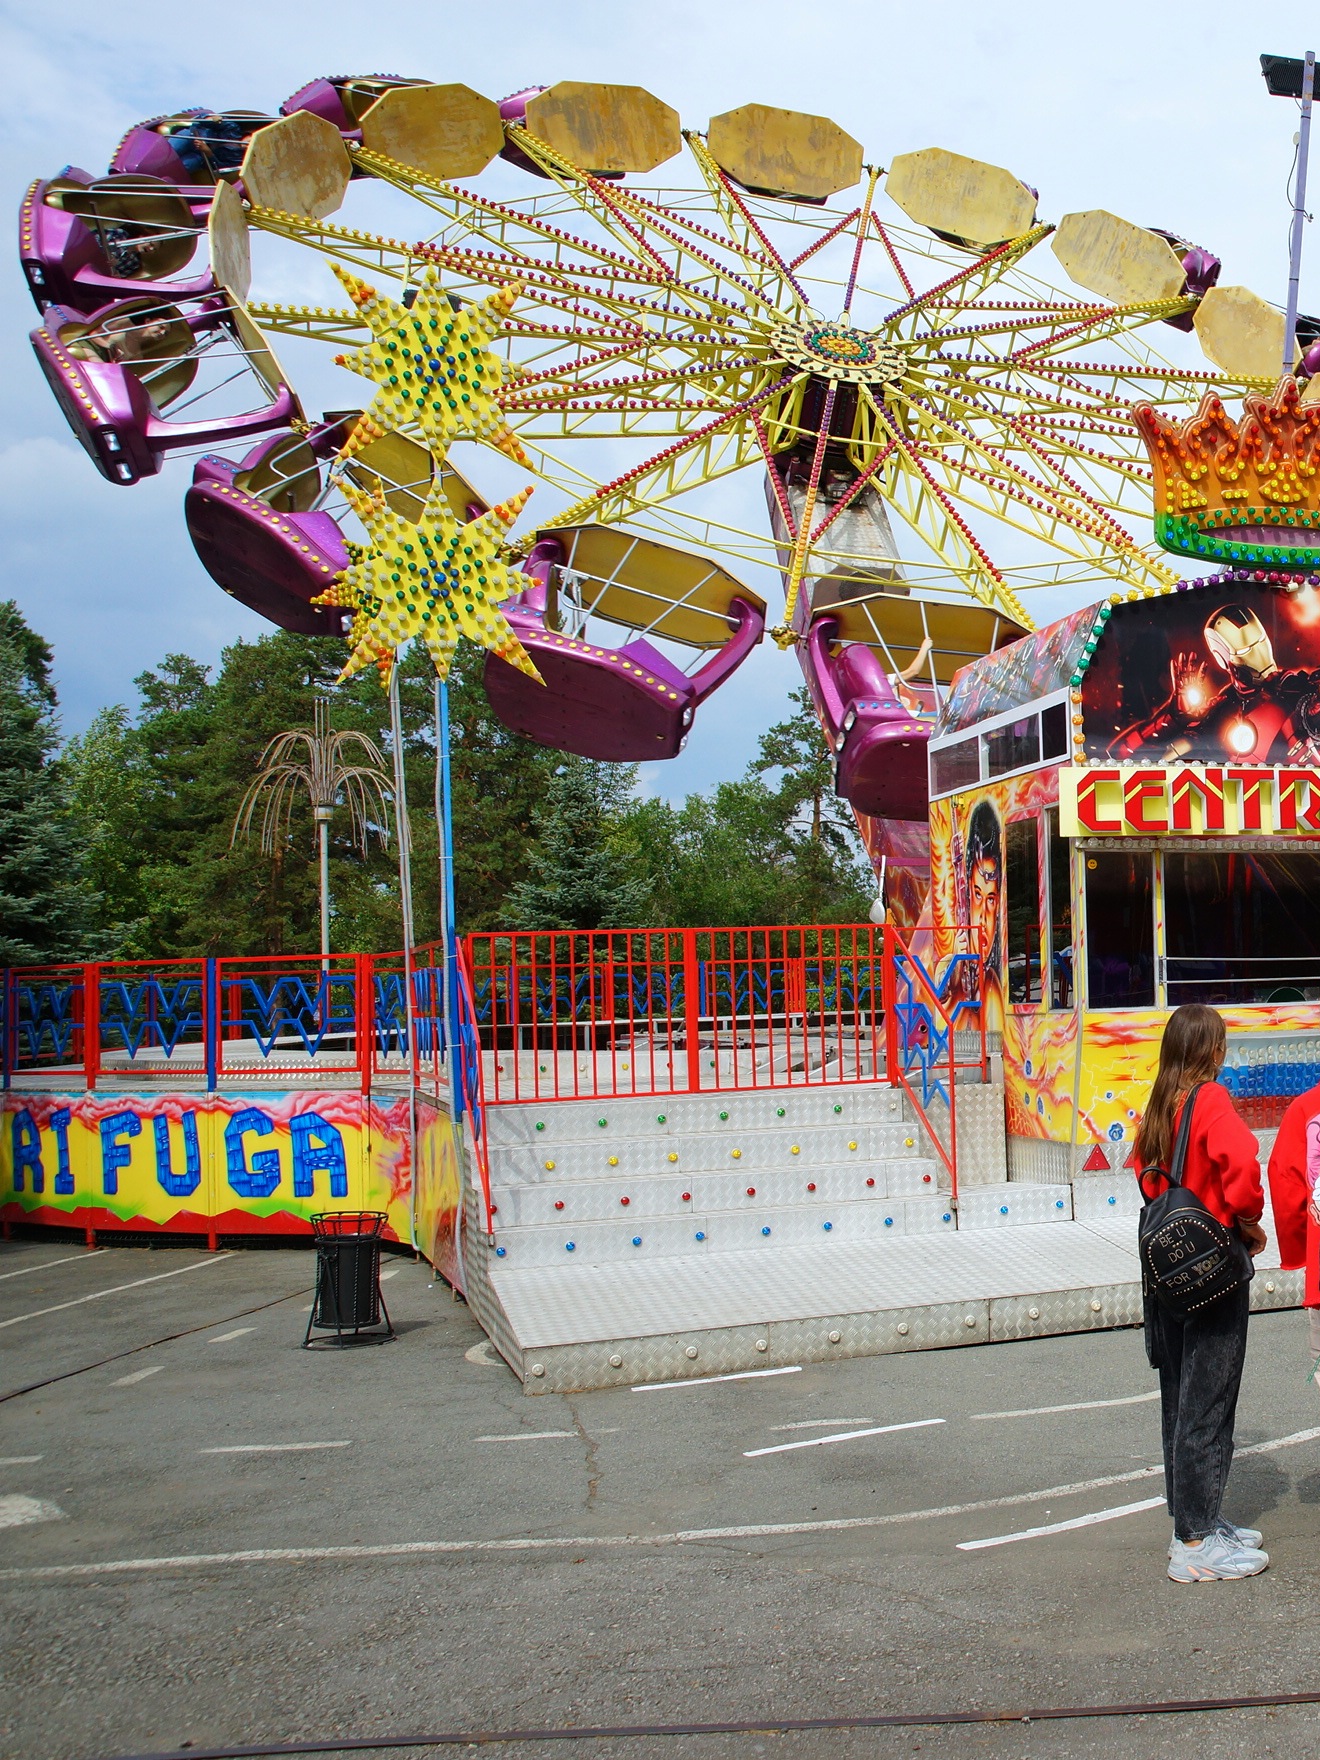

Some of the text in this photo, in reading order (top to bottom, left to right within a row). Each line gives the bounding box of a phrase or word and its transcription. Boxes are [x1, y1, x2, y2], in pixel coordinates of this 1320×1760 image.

[1159, 1225, 1187, 1248] BE U
[1167, 1241, 1196, 1263] DO U
[1166, 1254, 1220, 1288] FOR YOU
